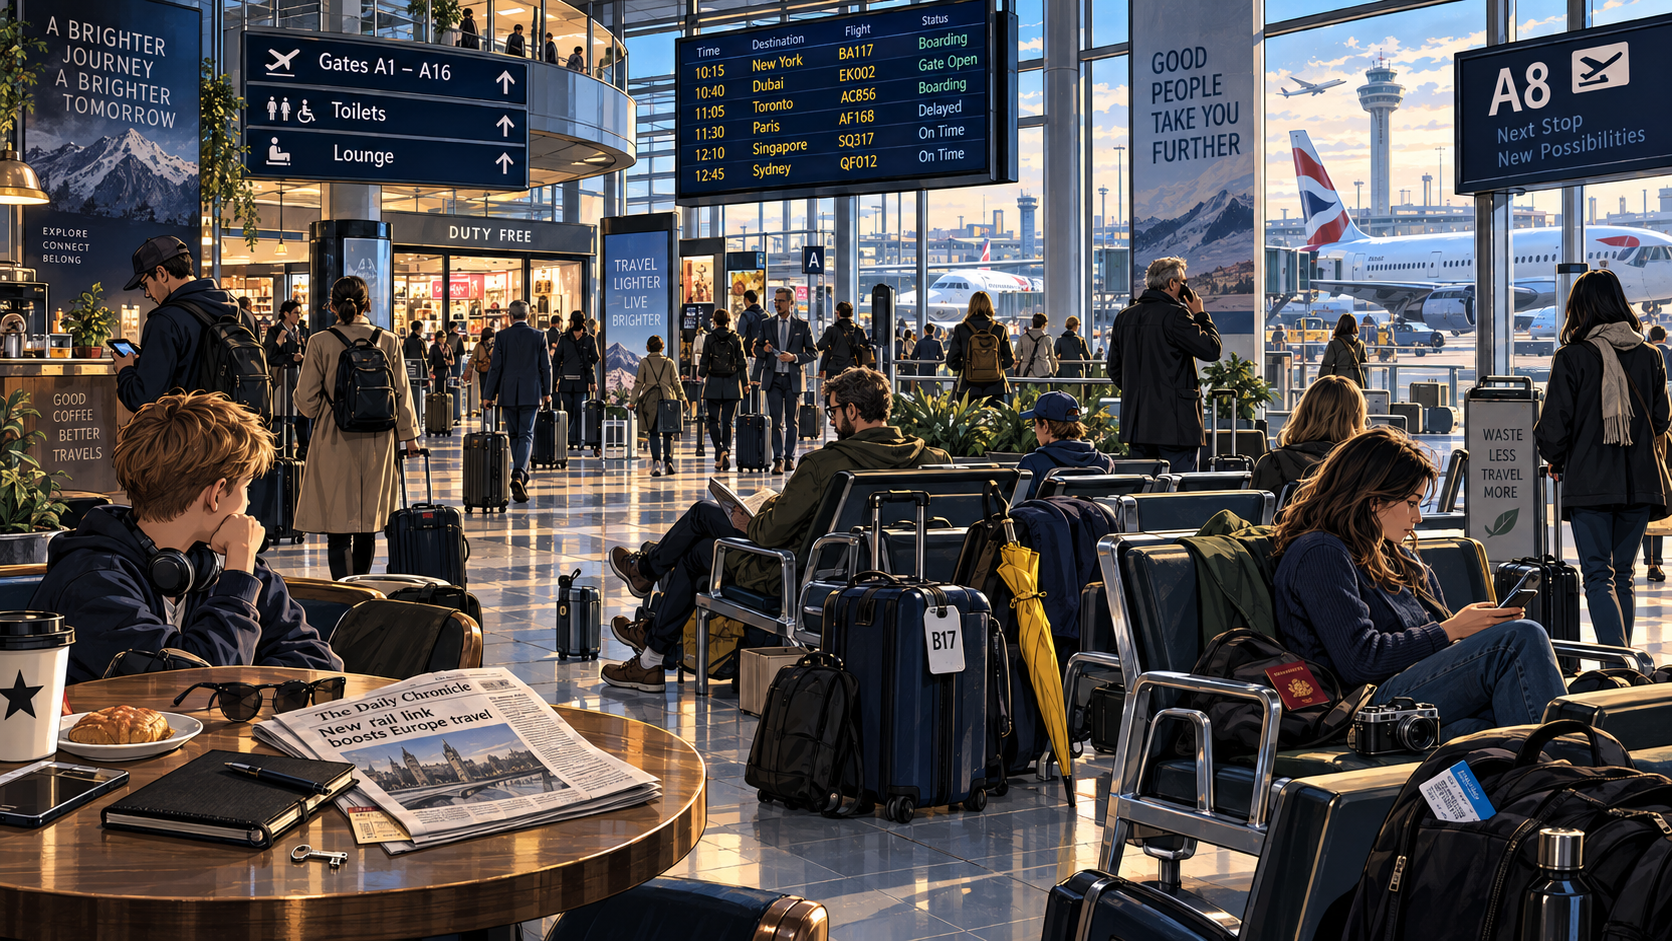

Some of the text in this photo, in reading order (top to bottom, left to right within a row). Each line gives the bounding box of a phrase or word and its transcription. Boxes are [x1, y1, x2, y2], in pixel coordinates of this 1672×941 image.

[47, 16, 165, 56] A BRIGHTER
[697, 15, 948, 57] Time Destination Flight Status
[63, 45, 153, 78] JOURNEY
[320, 53, 368, 73] Gates
[375, 58, 393, 75] A1
[419, 62, 450, 80] A16
[696, 33, 967, 79] 10:15 New York BA117 Boarding
[1152, 47, 1207, 74] GOOD
[56, 69, 170, 105] A BRIGHTER
[696, 55, 977, 99] 10:40 Dubai EK002 Gate Open
[1152, 74, 1222, 104] PEOPLE
[1489, 62, 1550, 116] A8
[63, 94, 175, 128] TOMORROW
[332, 102, 386, 121] Toilets
[696, 78, 966, 119] 11:05 Toronto AC856 Boarding
[696, 100, 961, 140] 11:30 Paris AF168 Delayed
[1151, 101, 1238, 133] TAKE YOU
[1498, 115, 1584, 143] Next Stop
[335, 145, 393, 167] Lounge
[696, 125, 964, 161] 12:10 Singapore SQ317 On Time
[1153, 133, 1240, 164] FURTHER
[1499, 128, 1645, 167] New Possibilities
[696, 148, 964, 181] 12:45 Sydney QF012 On Time
[43, 227, 87, 237] EXPLORE
[450, 226, 531, 242] DUTY FREE
[43, 241, 89, 251] CONNECT
[43, 255, 81, 264] BELONG
[809, 252, 819, 267] A
[615, 258, 657, 271] TRAVEL
[615, 276, 660, 289] LIGHTER
[625, 296, 647, 308] LIVE
[613, 313, 660, 326] BRIGHTER
[54, 393, 86, 405] GOOD
[53, 409, 92, 422] COFFEE
[60, 428, 99, 441] BETTER
[1483, 429, 1523, 440] WASTE
[53, 447, 102, 461] TRAVELS
[1490, 449, 1516, 461] LESS
[1482, 469, 1522, 480] TRAVEL
[1484, 486, 1517, 498] MORE
[932, 630, 956, 650] B17
[315, 710, 351, 721] The
[354, 698, 396, 712] Daily
[402, 683, 471, 701] Chronicle
[319, 708, 434, 737] New rail link
[327, 709, 492, 748] boosts Europe travel
